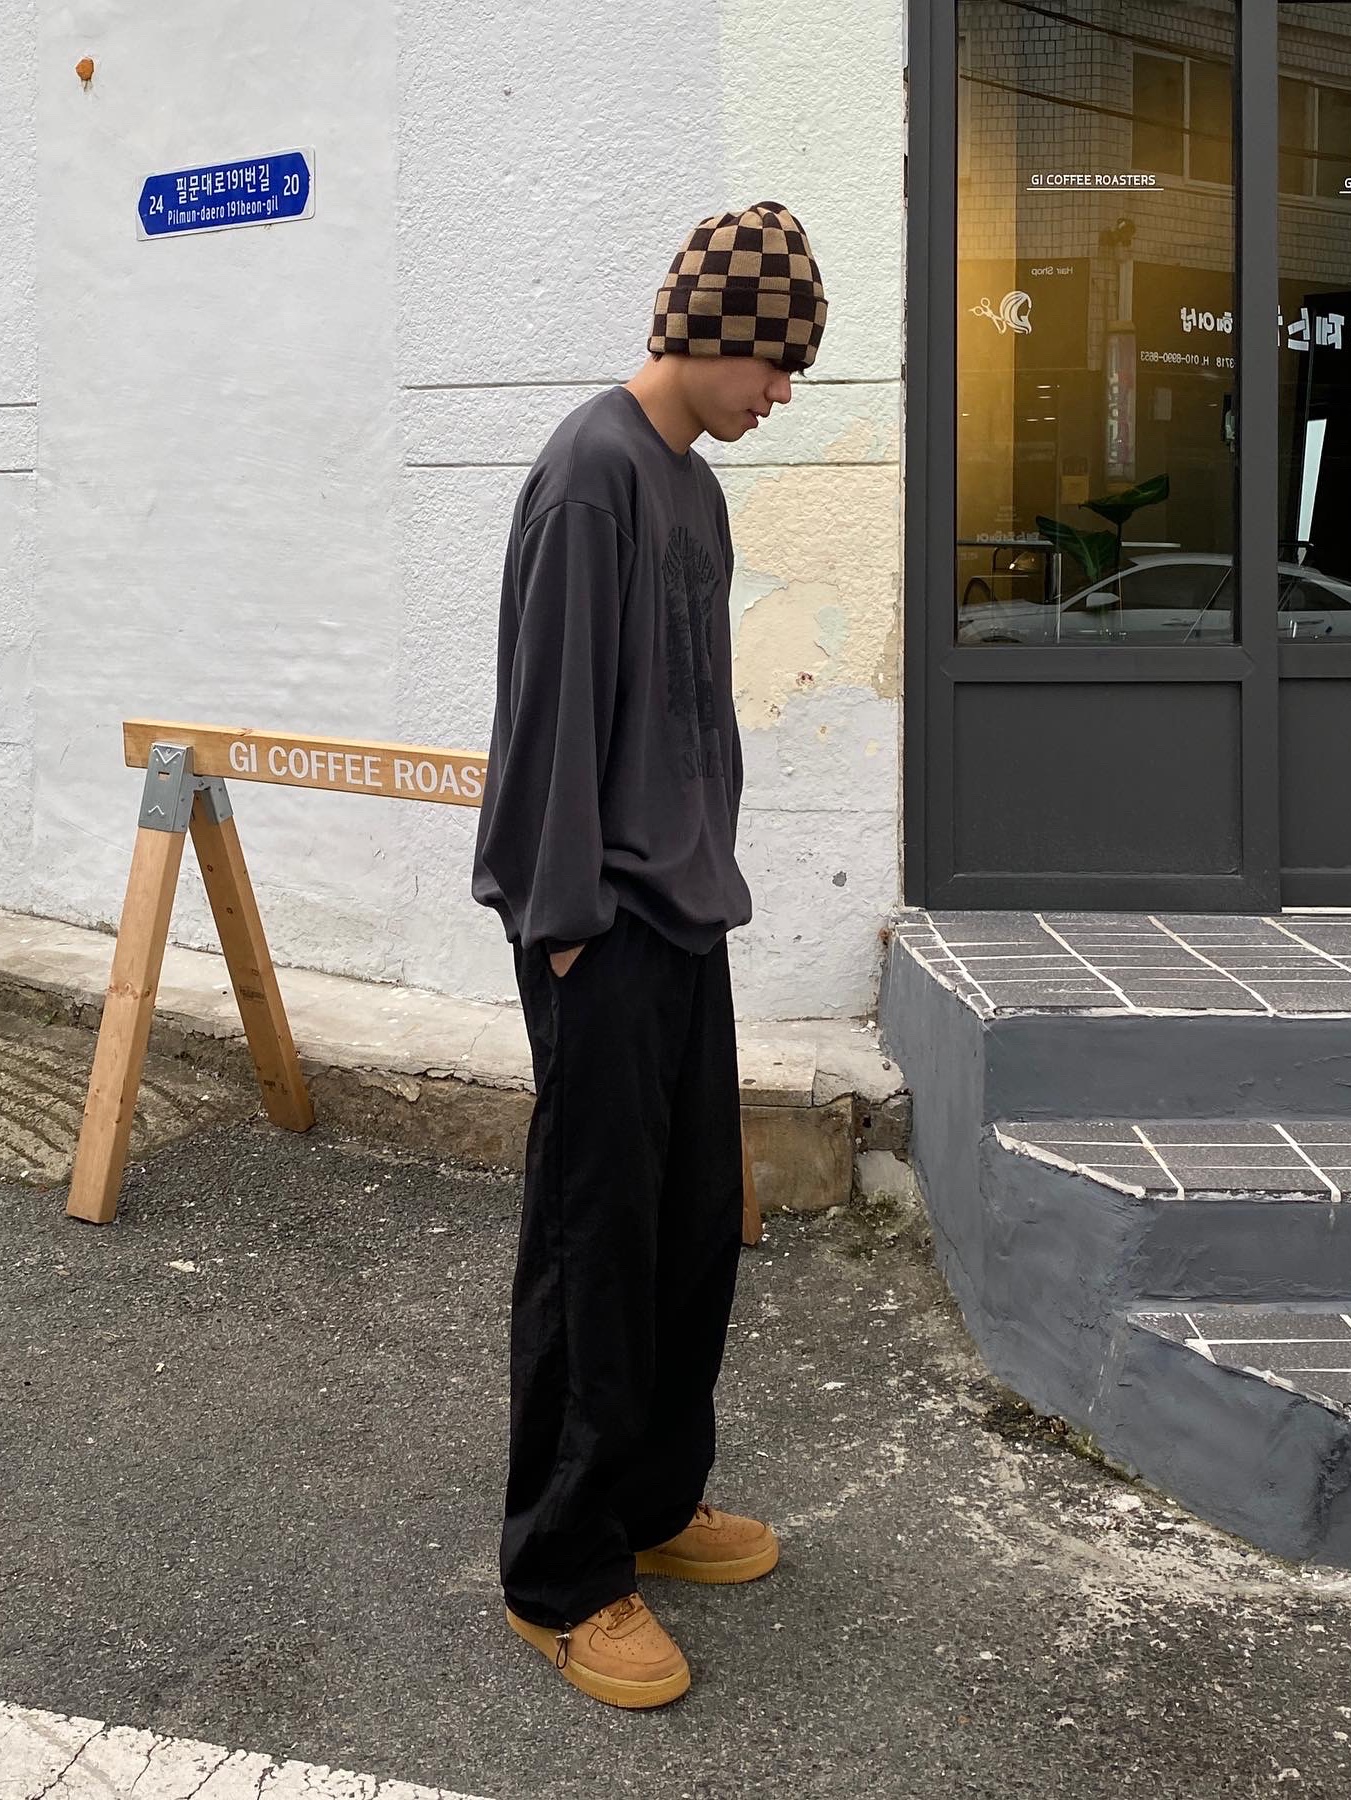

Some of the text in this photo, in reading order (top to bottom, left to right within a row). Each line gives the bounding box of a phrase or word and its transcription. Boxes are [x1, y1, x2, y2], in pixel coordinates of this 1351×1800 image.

[176, 163, 270, 204] 필문대로191번길
[283, 173, 300, 196] 20
[1031, 174, 1156, 186] GI COFFEE ROASTERS
[149, 194, 164, 215] 24
[167, 194, 279, 225] Pilmun-daero 191beon-gil
[229, 741, 487, 798] GI COFFEE ROAS
